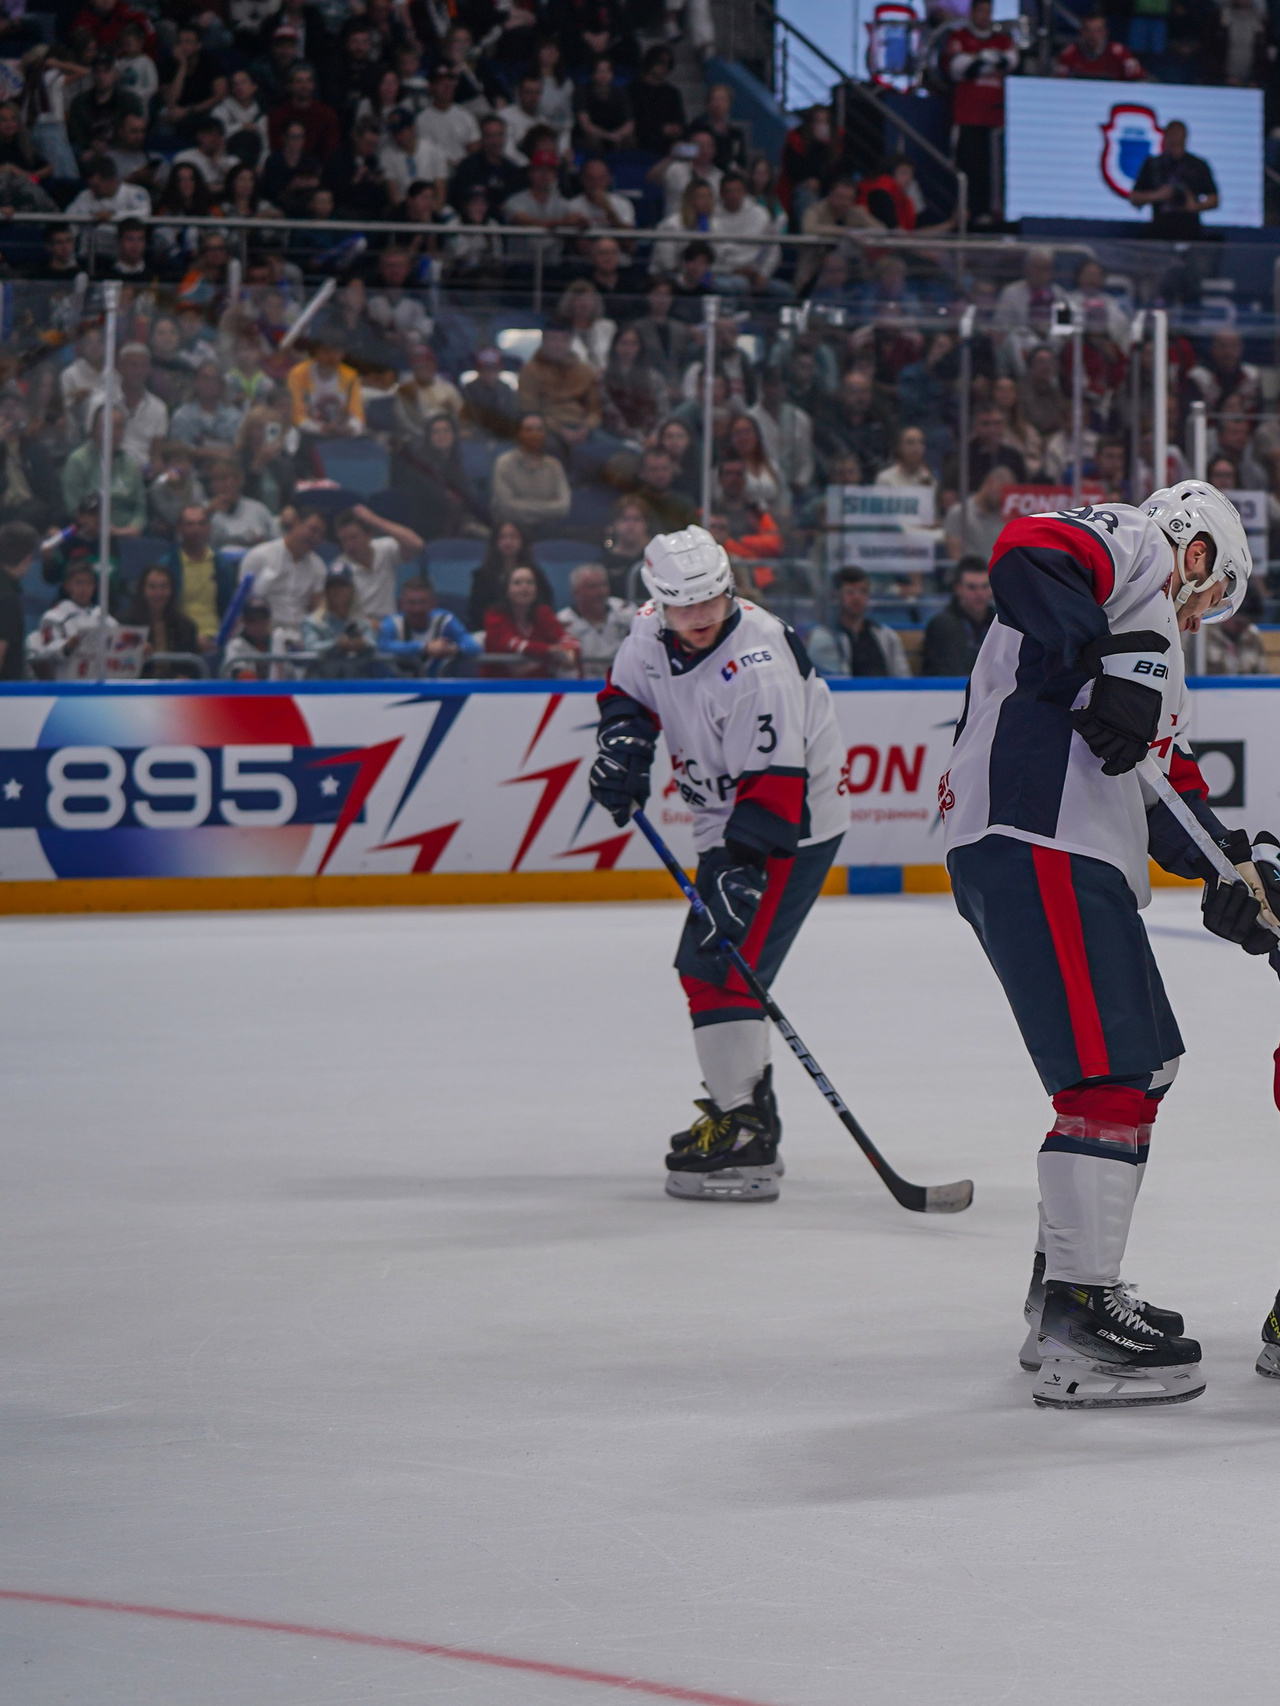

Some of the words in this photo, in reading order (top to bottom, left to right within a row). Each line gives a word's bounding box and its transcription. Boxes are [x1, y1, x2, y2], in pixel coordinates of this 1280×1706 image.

[740, 651, 772, 667] ПСБ
[757, 714, 777, 753] 3
[46, 744, 297, 829] 895
